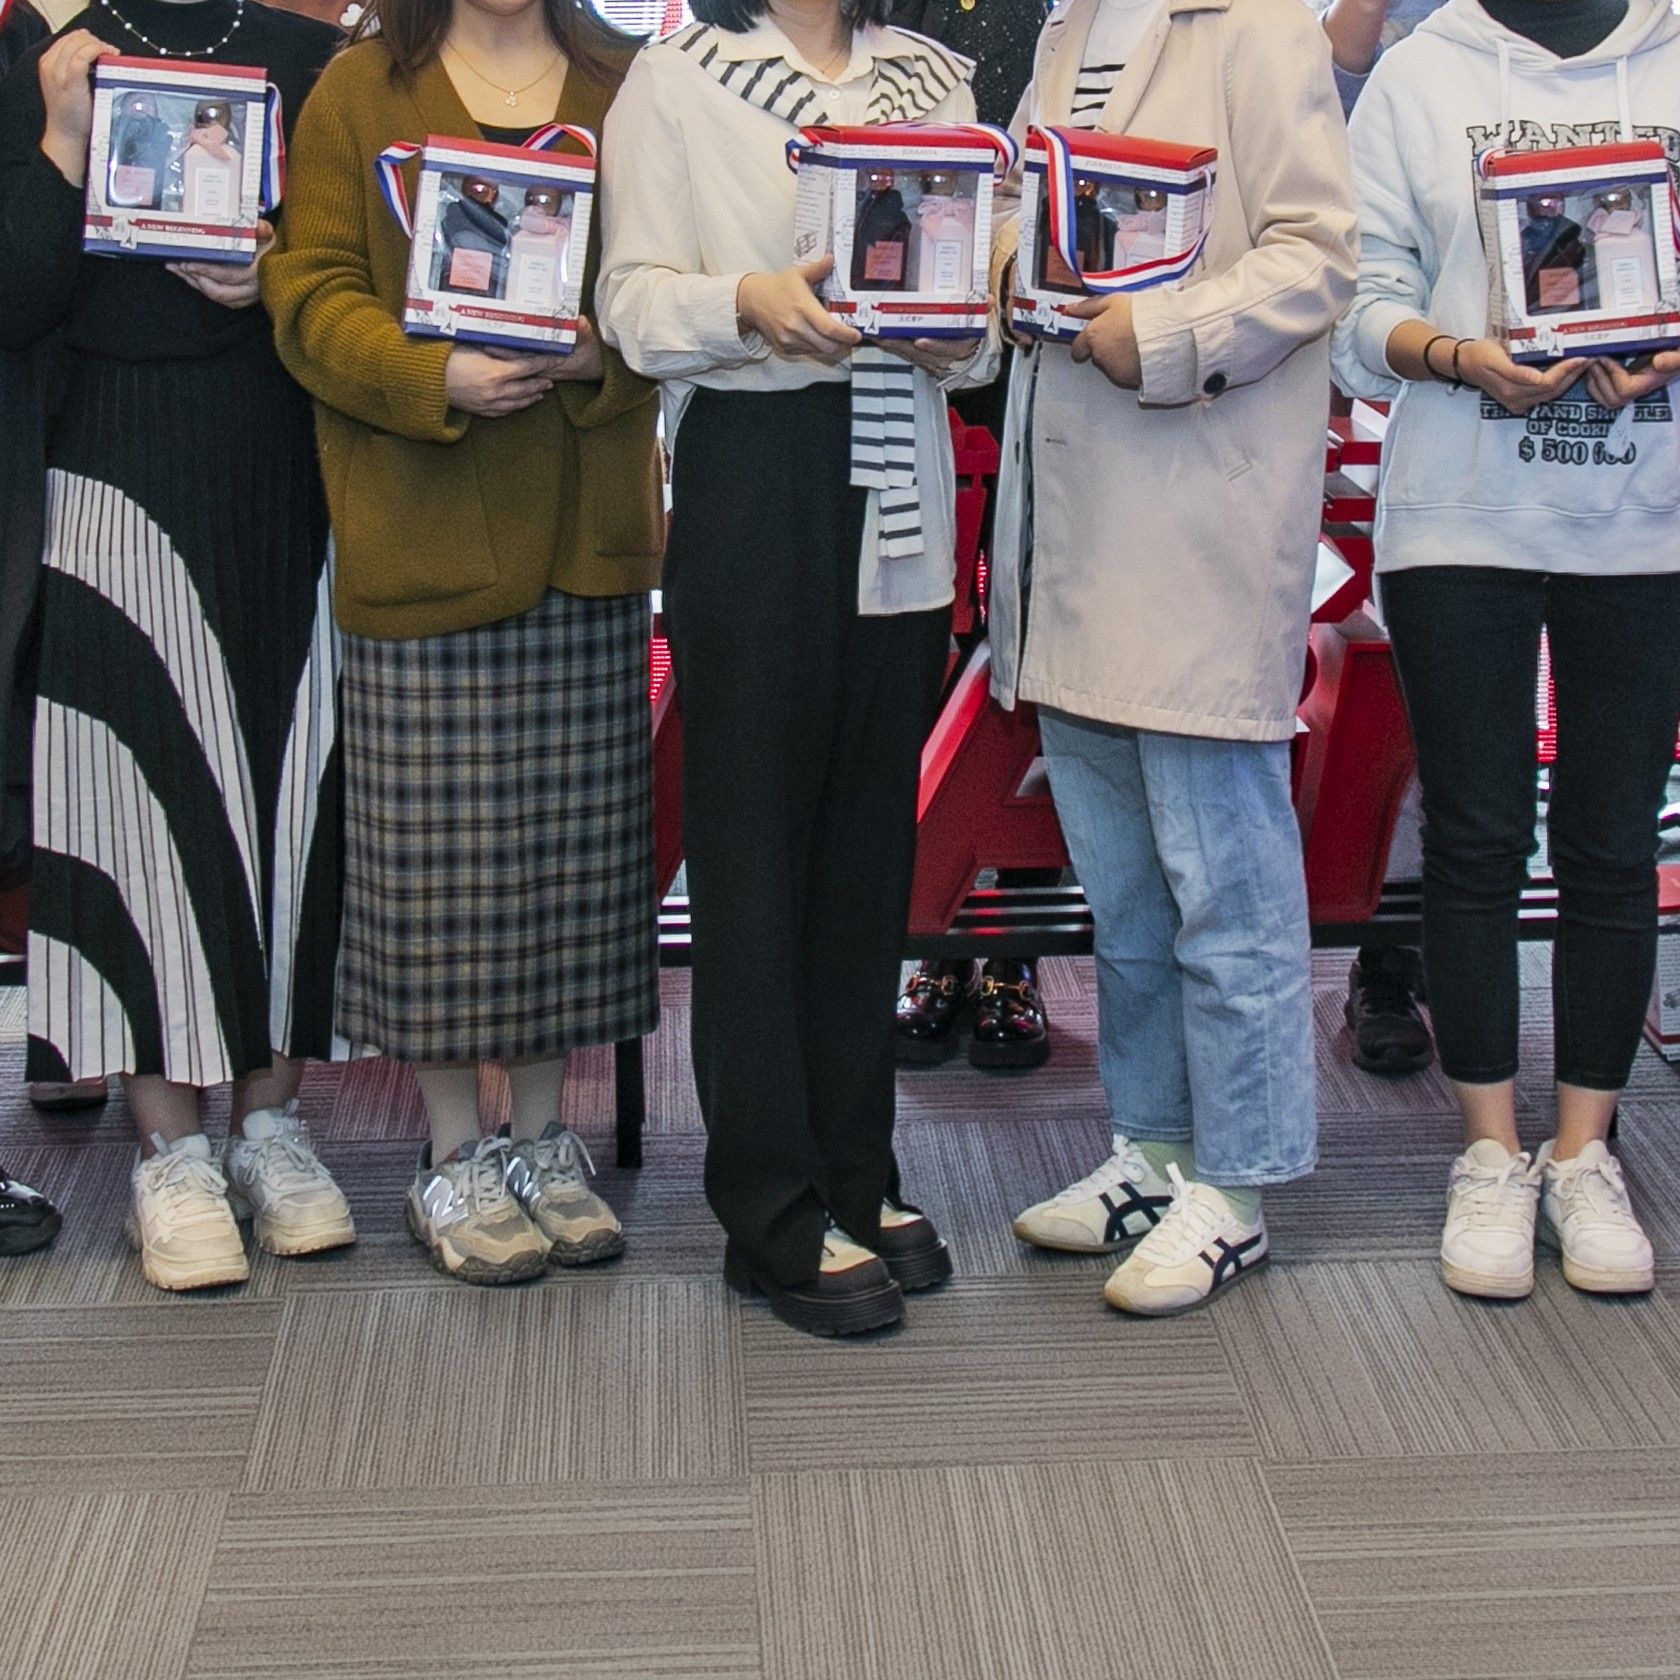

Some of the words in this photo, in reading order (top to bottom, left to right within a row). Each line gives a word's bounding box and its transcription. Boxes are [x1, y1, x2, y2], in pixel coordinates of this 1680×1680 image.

[1527, 419, 1553, 436] OF
[1555, 420, 1608, 438] COOKI
[1541, 437, 1589, 465] 500
